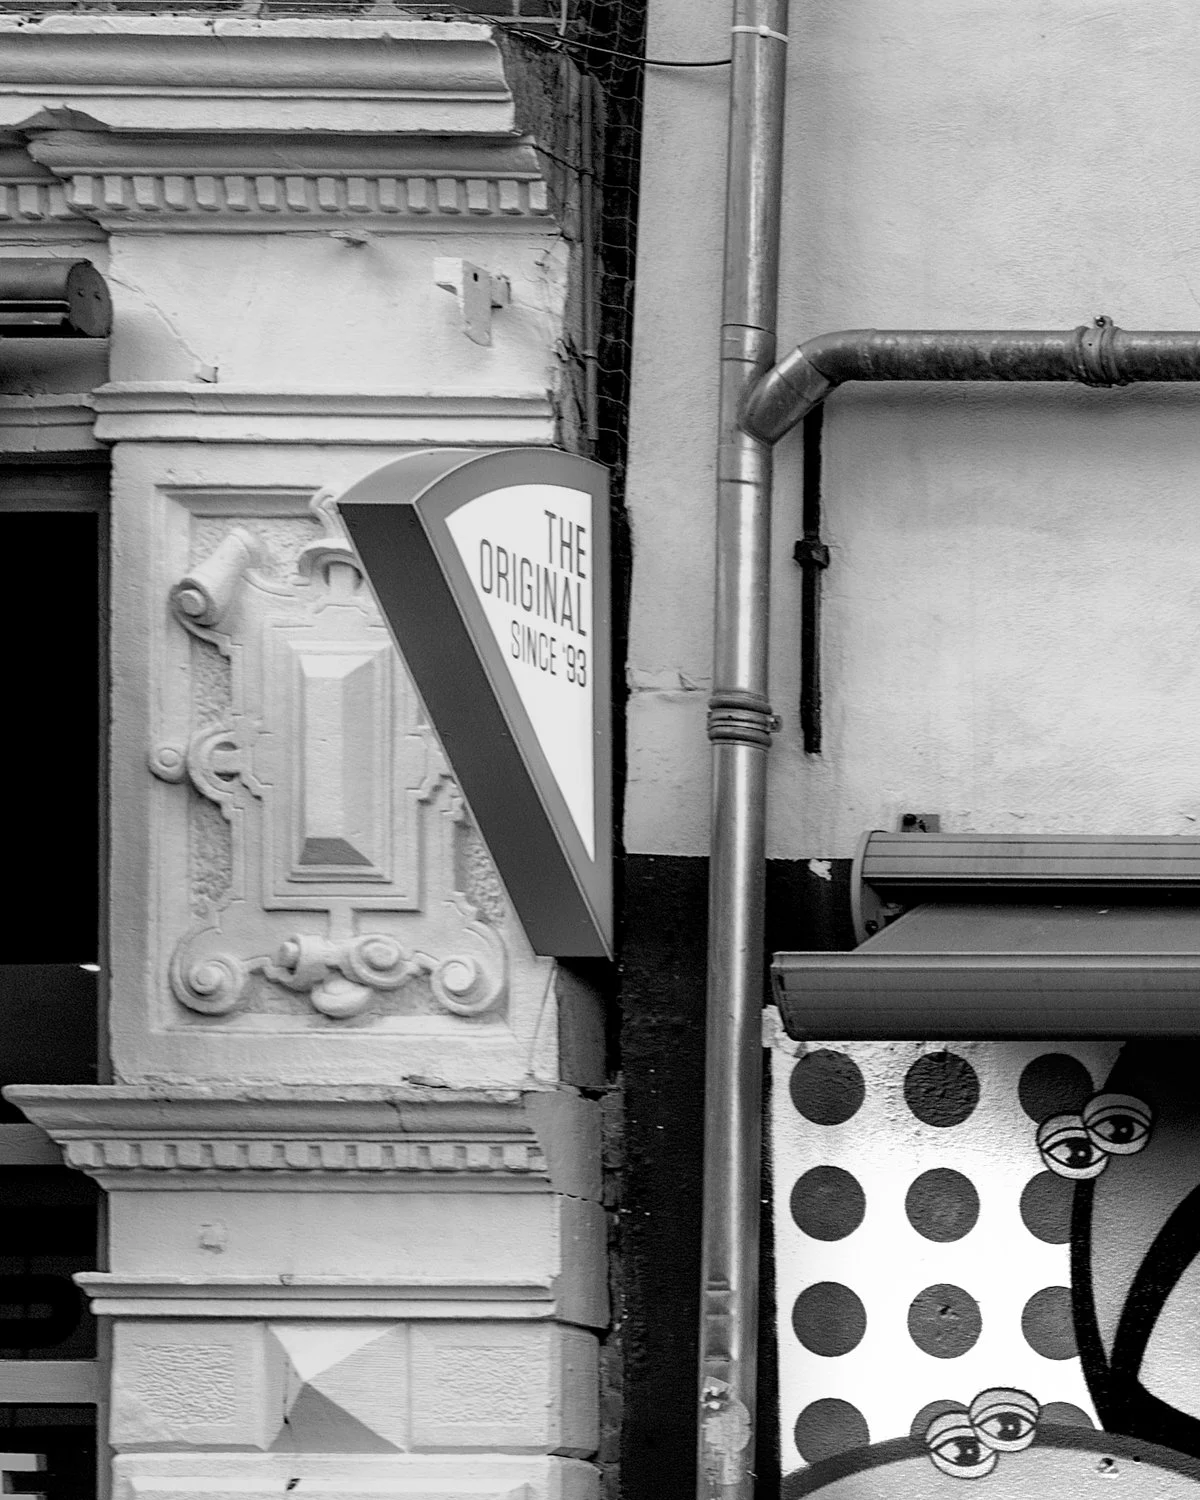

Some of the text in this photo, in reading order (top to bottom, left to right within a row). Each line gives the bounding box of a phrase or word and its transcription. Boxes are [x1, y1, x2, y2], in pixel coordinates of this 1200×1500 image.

[544, 509, 588, 579] THE
[479, 538, 588, 637] ORIGINAL
[510, 619, 588, 689] SINCE '93
